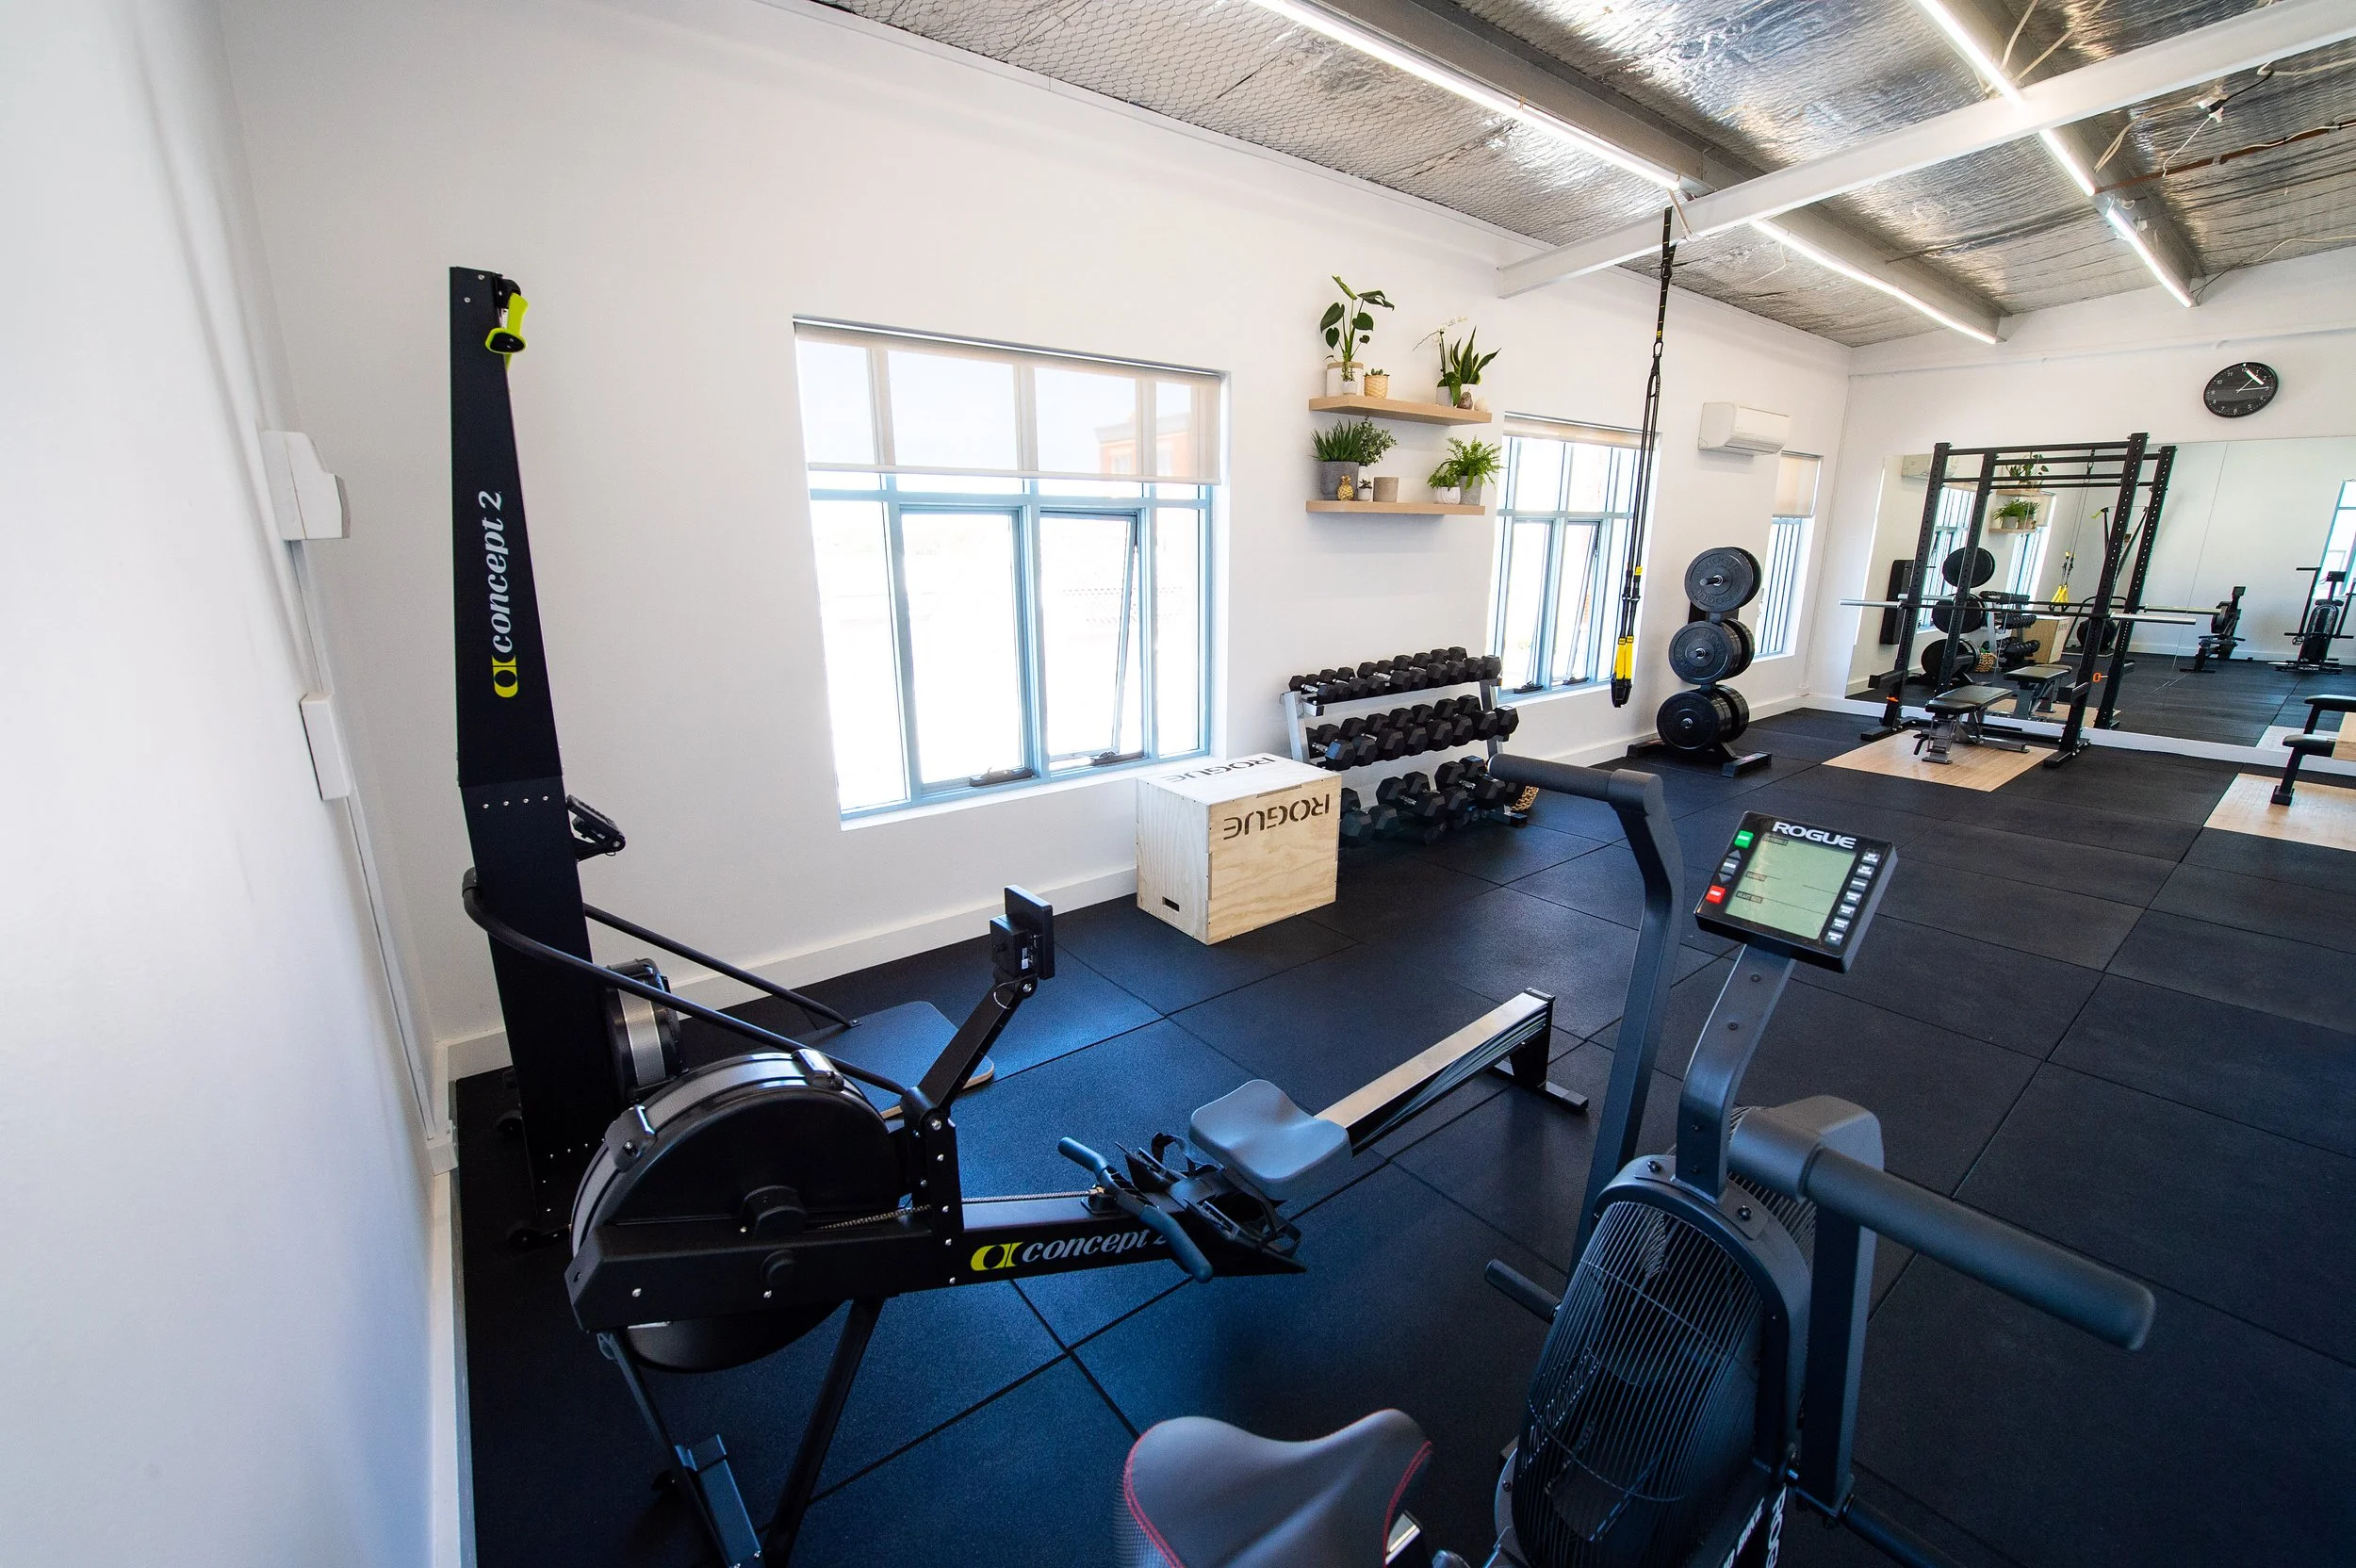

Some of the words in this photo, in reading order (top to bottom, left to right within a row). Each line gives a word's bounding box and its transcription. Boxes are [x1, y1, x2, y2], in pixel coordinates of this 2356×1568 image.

[478, 490, 502, 512] 2
[482, 516, 513, 654] concept
[1161, 757, 1276, 783] ROGUE
[1223, 793, 1330, 841] ROGUE
[1772, 821, 1857, 850] ROGUE
[1022, 1228, 1151, 1263] concept
